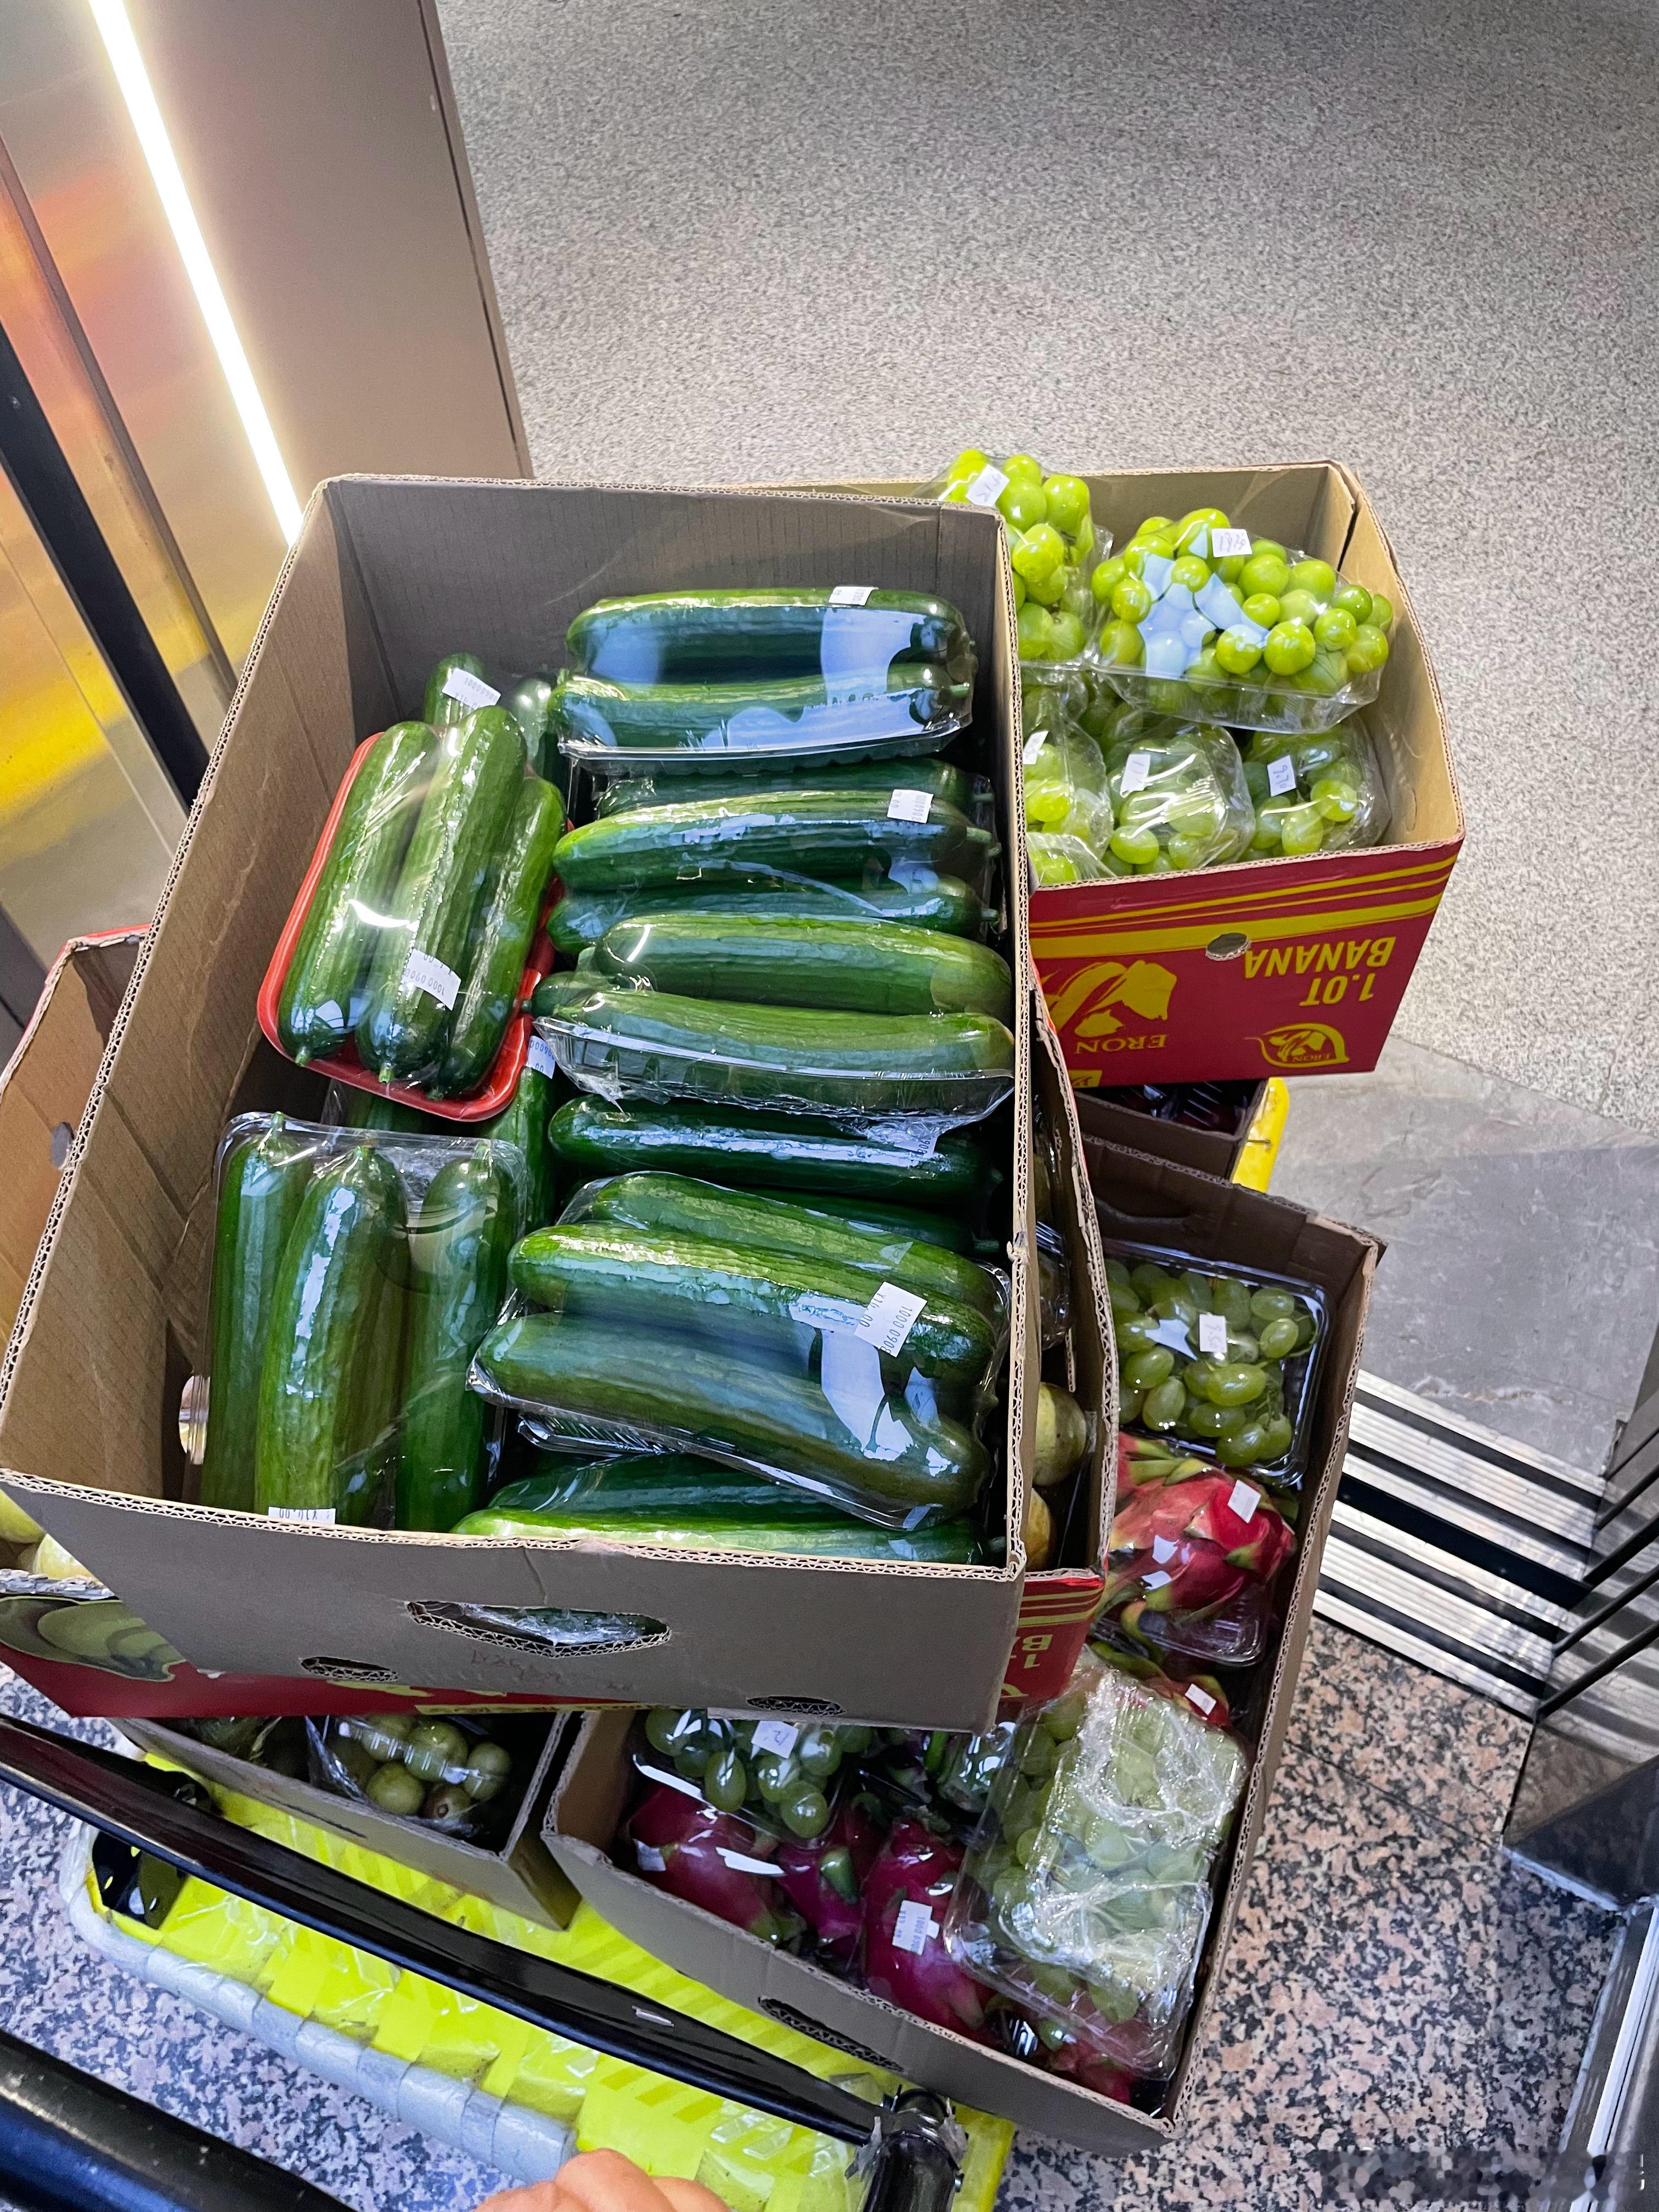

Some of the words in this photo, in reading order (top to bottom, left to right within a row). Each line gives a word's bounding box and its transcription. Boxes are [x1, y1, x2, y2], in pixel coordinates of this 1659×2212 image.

[1245, 936, 1396, 979] BANANA
[1299, 973, 1376, 1006] 1.0T
[1074, 1034, 1167, 1054] ERON
